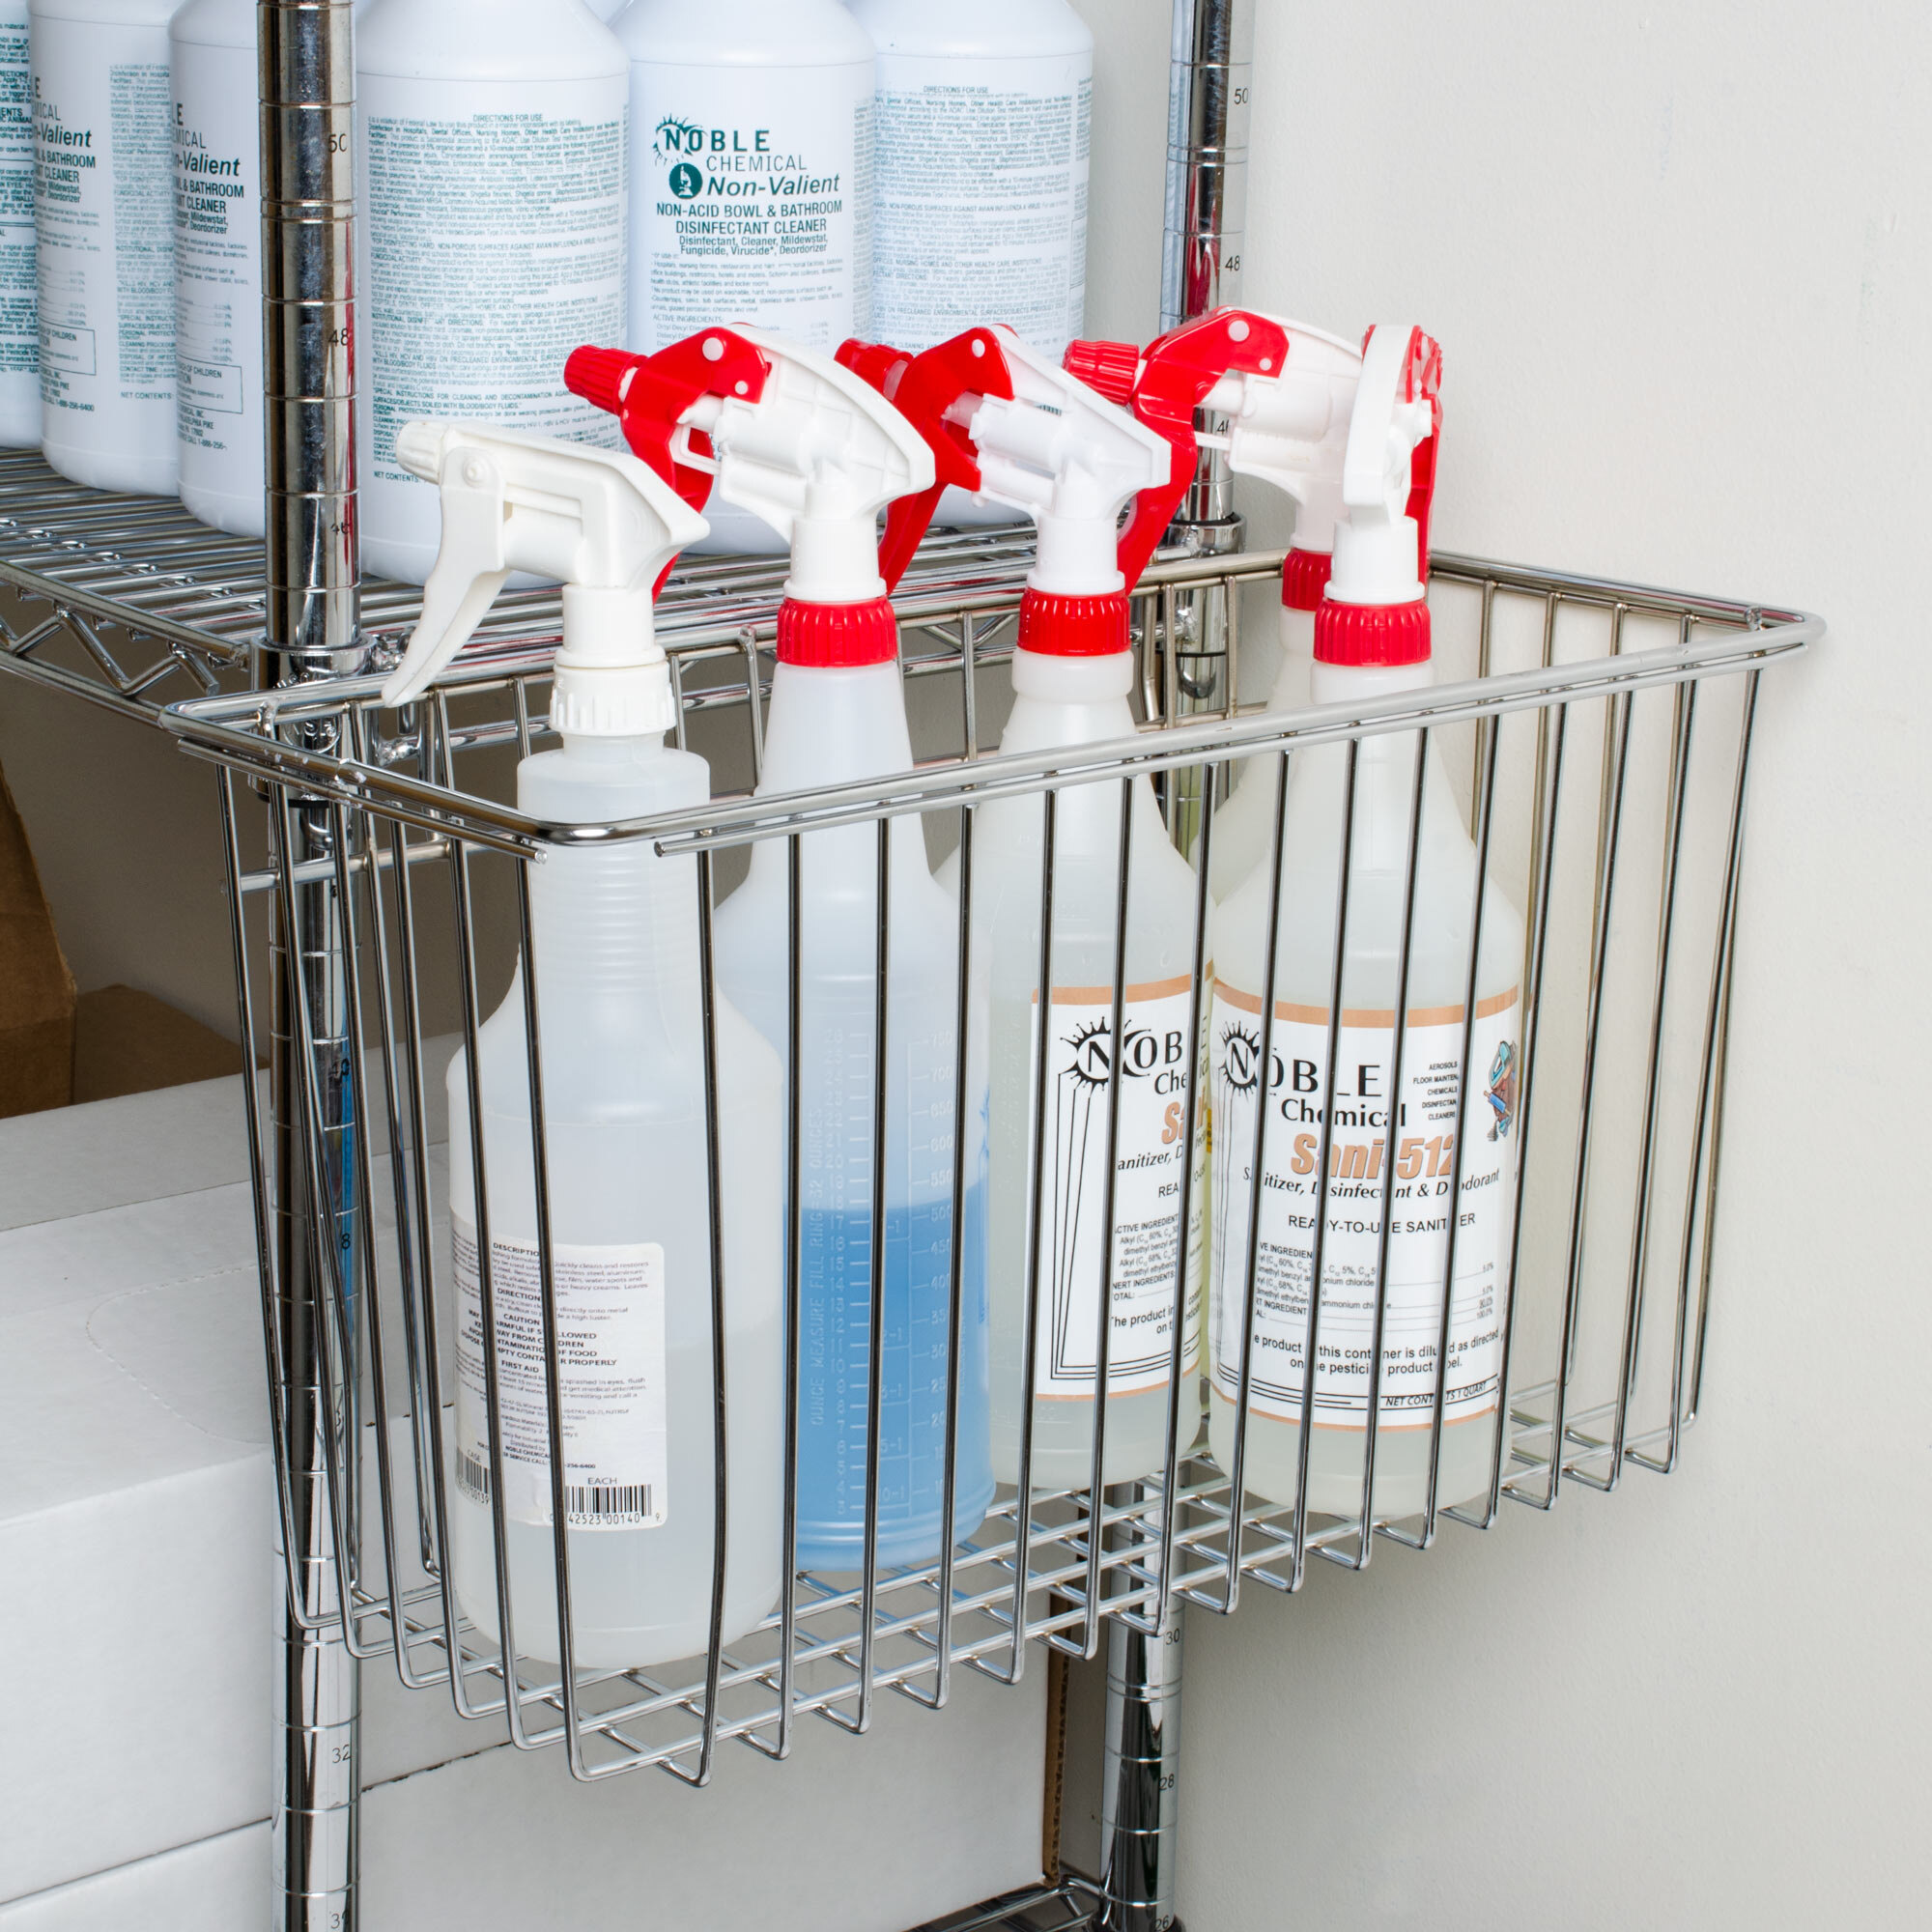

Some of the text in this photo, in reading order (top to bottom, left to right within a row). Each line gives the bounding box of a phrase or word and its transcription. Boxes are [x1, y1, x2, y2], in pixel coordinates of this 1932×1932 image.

[1234, 88, 1248, 105] 50
[472, 113, 543, 122] DIRECTIONS FOR USE
[663, 128, 770, 152] NOBLE
[47, 151, 96, 168] BATHROOM
[706, 155, 808, 172] CHEMICAL
[44, 167, 79, 184] CLEANER
[189, 180, 244, 198] BATHROOM
[707, 174, 839, 196] Non-Valient
[186, 196, 227, 213] CLEANER
[657, 200, 842, 217] NON-ACID BOWL & BATHROOM
[190, 212, 228, 225] Mildewstat,
[676, 218, 827, 235] DISINFECTANT CLEANER
[679, 234, 828, 247] Disinfectant, Cleaner, Mildewstat,
[680, 245, 729, 257] Fungicide,
[780, 243, 827, 254] Deordorizer
[1225, 255, 1240, 271] 48
[327, 327, 349, 347] 48
[193, 367, 222, 378] CHILDREN
[373, 470, 384, 479] NET
[1231, 1042, 1381, 1097] NOBE
[1429, 1061, 1458, 1071] AEROSOLS
[1422, 1099, 1457, 1109] DISINFECTAN
[1118, 1150, 1171, 1171] anitizer,
[1291, 1131, 1454, 1179] Sani512
[1243, 1166, 1500, 1199] Sitizer, sinfecnt & Ddorant
[1114, 1213, 1179, 1235] CTIVE INGREDIENT
[1289, 1212, 1476, 1234] REAY-TO-UE SANITER
[493, 1242, 540, 1257] DESCRIPTIO
[1123, 1240, 1168, 1256] dimethyl benzyl
[1270, 1243, 1313, 1259] INGREDIEN
[1113, 1269, 1176, 1290] NERT INGREDIENTS:
[1123, 1266, 1150, 1278] dimethyl
[1258, 1265, 1375, 1287] imethyl benzyl chloride
[497, 1288, 541, 1301] DIRECTION
[1113, 1292, 1135, 1301] OTAL:
[1264, 1299, 1307, 1315] INGREDIENT
[1321, 1300, 1361, 1309] ammonium
[503, 1314, 540, 1326] CAUTION
[1111, 1307, 1166, 1328] he product
[497, 1321, 526, 1333] ARMFUL
[537, 1327, 597, 1339] SLOWED
[1156, 1323, 1167, 1334] on
[512, 1333, 584, 1349] FROM CDREN
[1263, 1326, 1499, 1359] product this contner is dild as directed
[497, 1348, 515, 1357] MPTY
[517, 1351, 567, 1365] CONTAR
[501, 1359, 539, 1373] FIRST AID
[1290, 1358, 1433, 1377] on pestici product
[1385, 1396, 1405, 1406] NET
[1407, 1390, 1455, 1406] CONTTS
[1463, 1381, 1487, 1397] QUART
[568, 1514, 602, 1524] 42523
[607, 1513, 640, 1524] 00140
[1165, 1628, 1180, 1645] 30
[331, 1744, 352, 1764] 32
[1159, 1774, 1175, 1790] 28
[1154, 1915, 1170, 1930] 26
